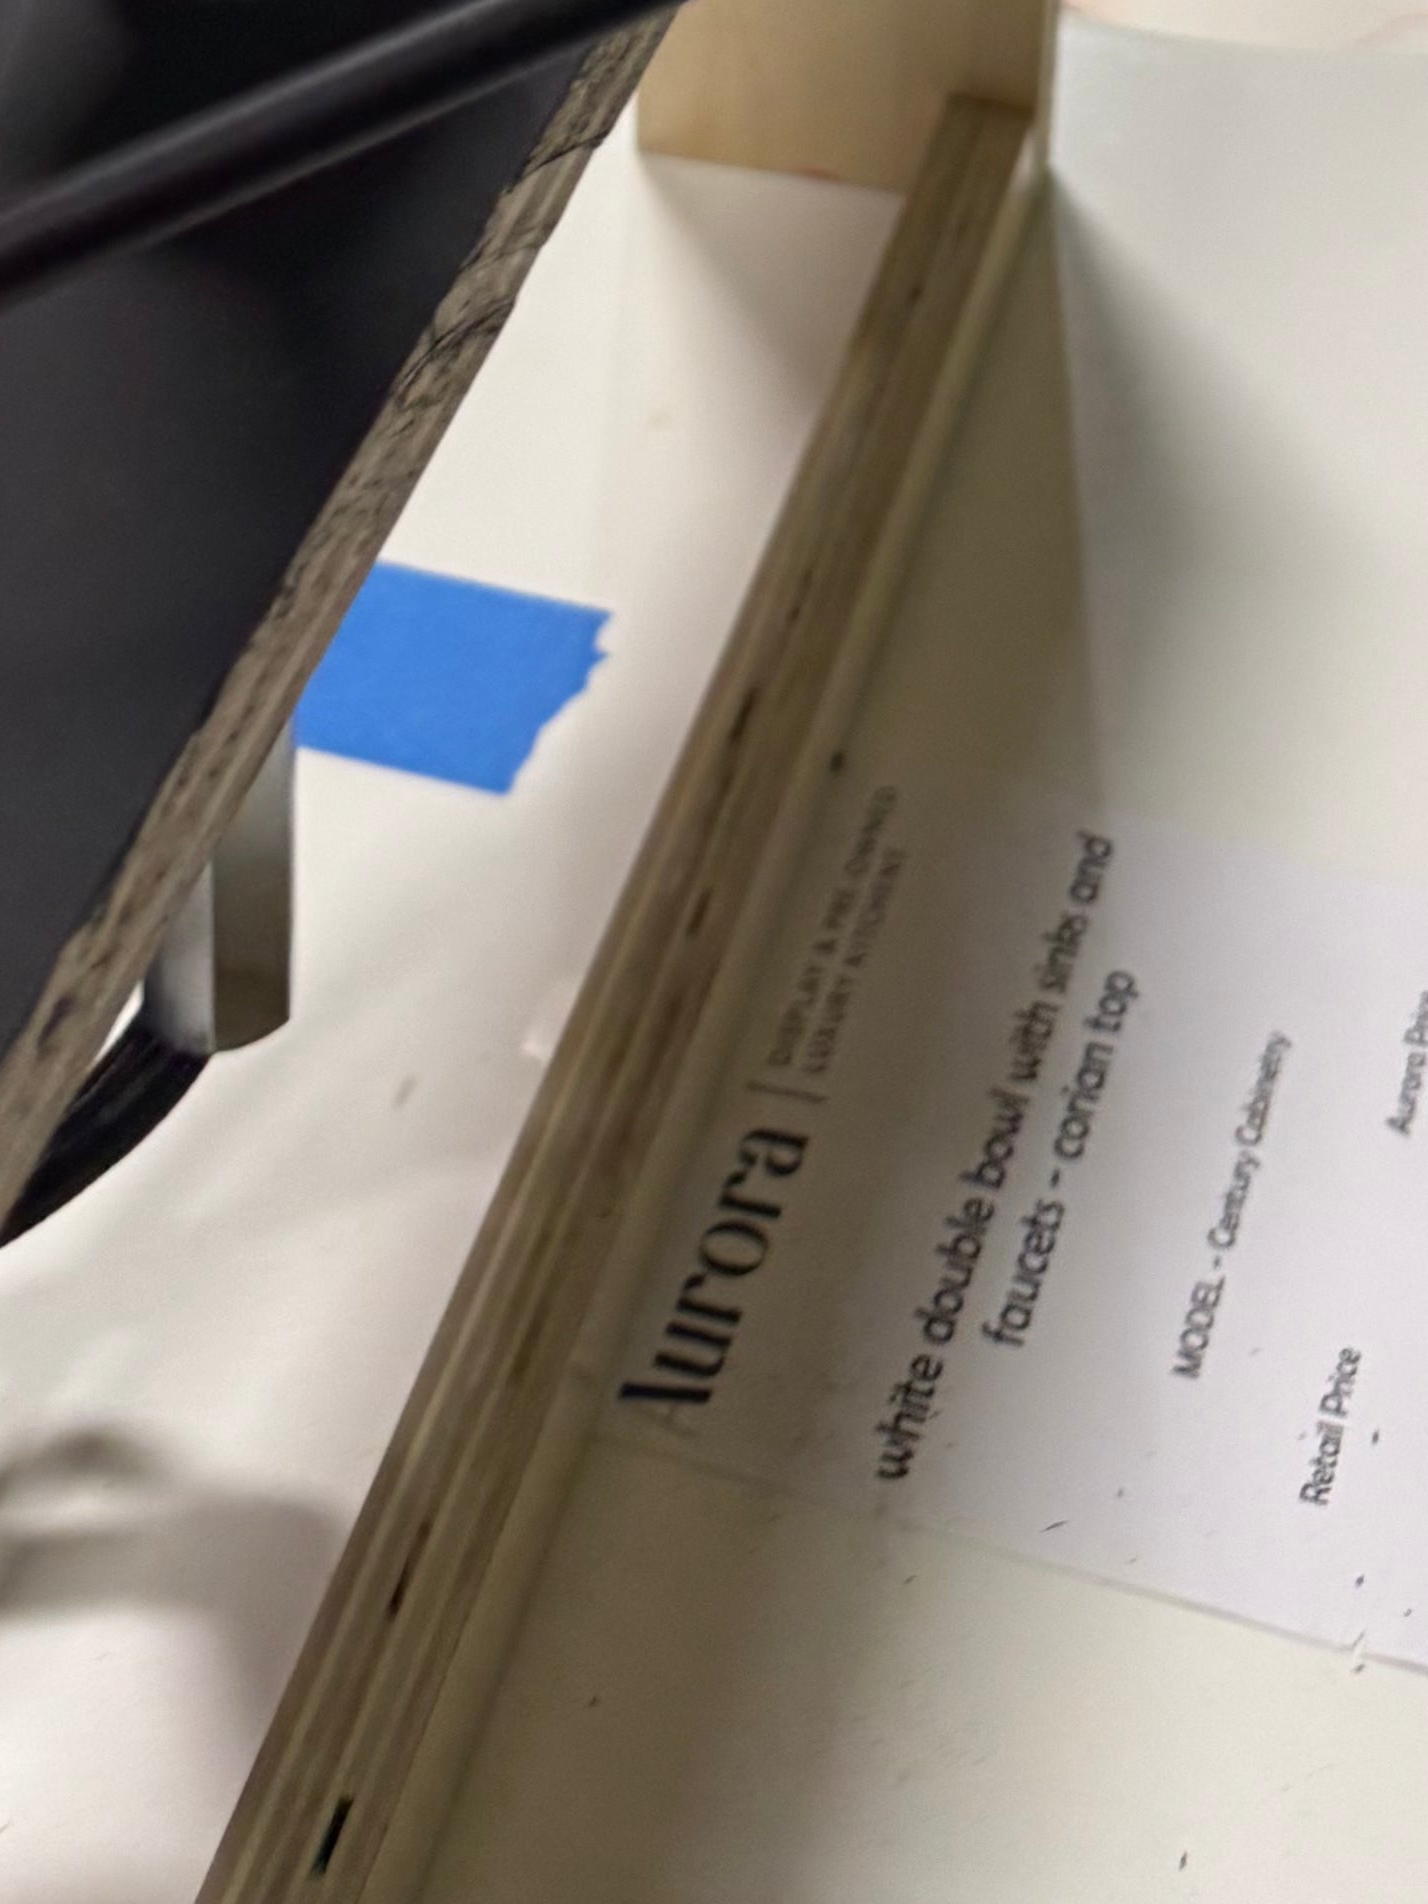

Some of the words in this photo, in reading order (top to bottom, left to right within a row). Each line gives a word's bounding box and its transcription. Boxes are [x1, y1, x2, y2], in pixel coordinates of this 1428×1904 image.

[877, 1353, 942, 1481] white
[914, 1198, 995, 1346] double
[960, 1090, 1031, 1190] bowl
[1009, 999, 1058, 1082] with
[1038, 910, 1087, 993] sinks
[1069, 830, 1114, 908] and
[982, 1200, 1065, 1349] faucets
[1053, 1039, 1112, 1160] corian
[1084, 969, 1140, 1035] top
[1385, 1052, 1428, 1138] Aurora
[617, 1125, 810, 1432] Aurora
[1173, 1275, 1226, 1380] MODEL
[1208, 1150, 1261, 1251] Century
[1299, 1420, 1345, 1507] Retail
[1320, 1346, 1362, 1418] Price
